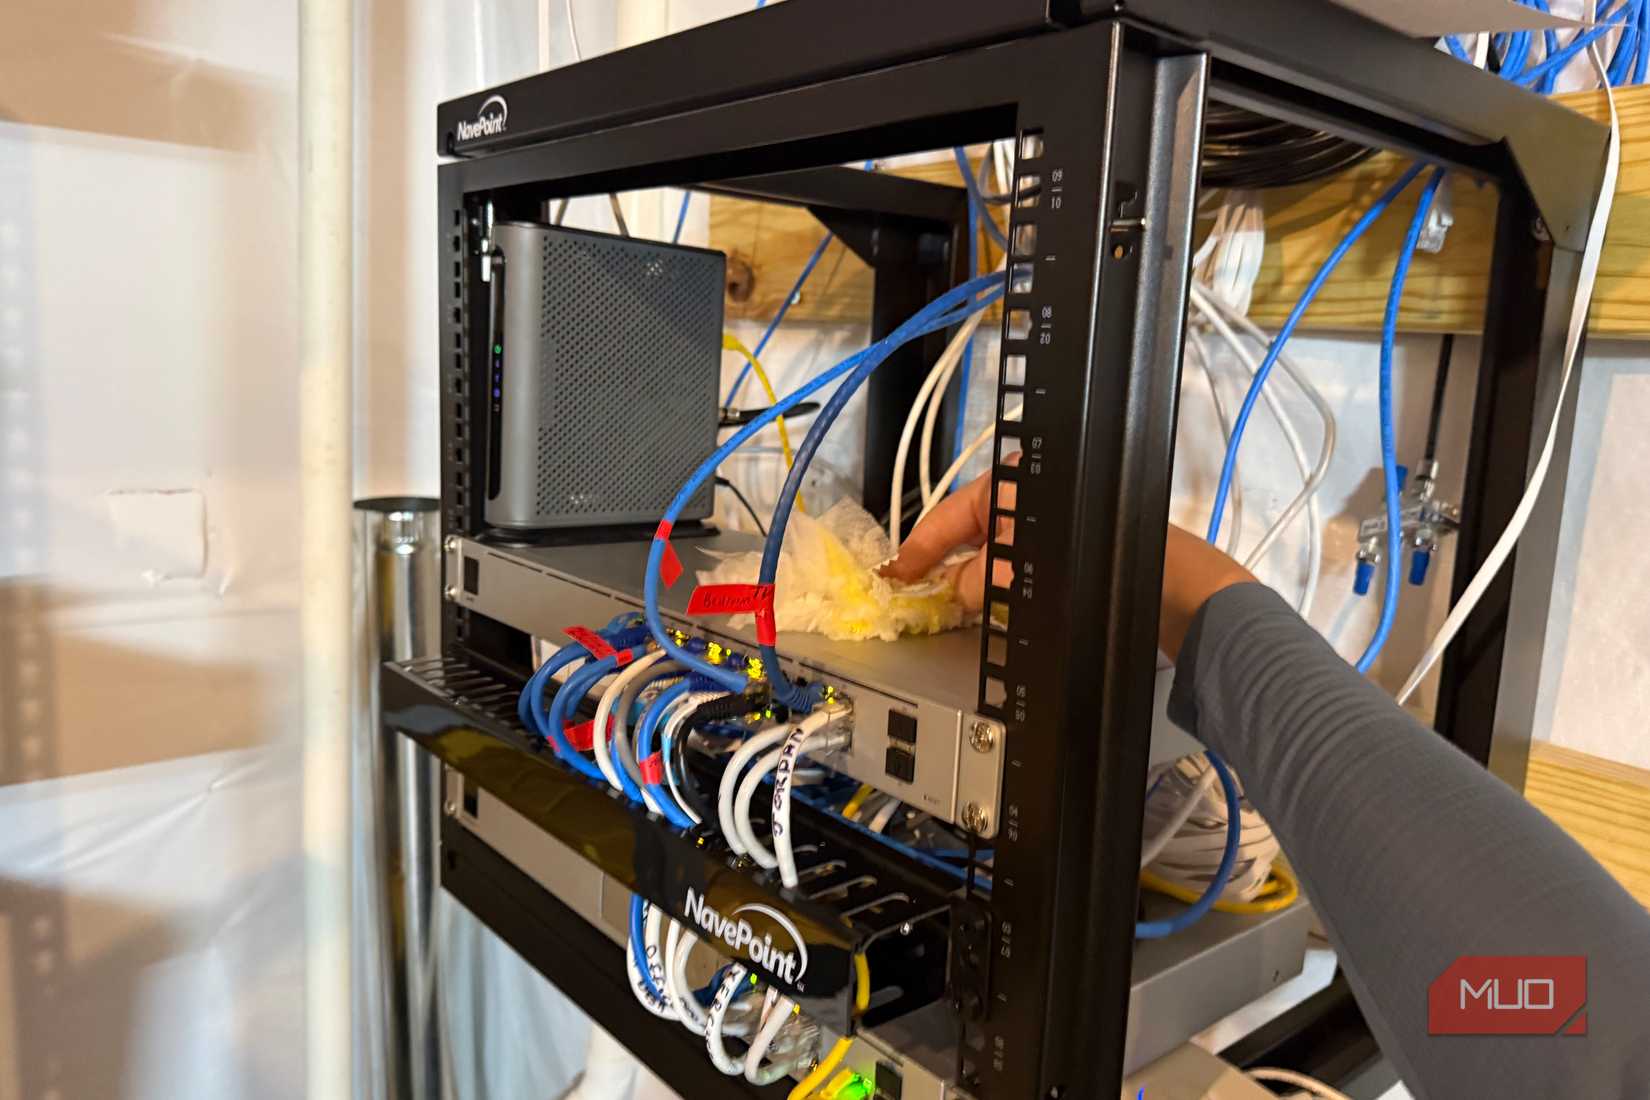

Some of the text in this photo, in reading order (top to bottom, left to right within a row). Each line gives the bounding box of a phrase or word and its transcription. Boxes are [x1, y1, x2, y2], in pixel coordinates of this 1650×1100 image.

[457, 112, 502, 141] NavePoint
[1052, 169, 1063, 183] 09
[684, 886, 798, 985] NavePoint
